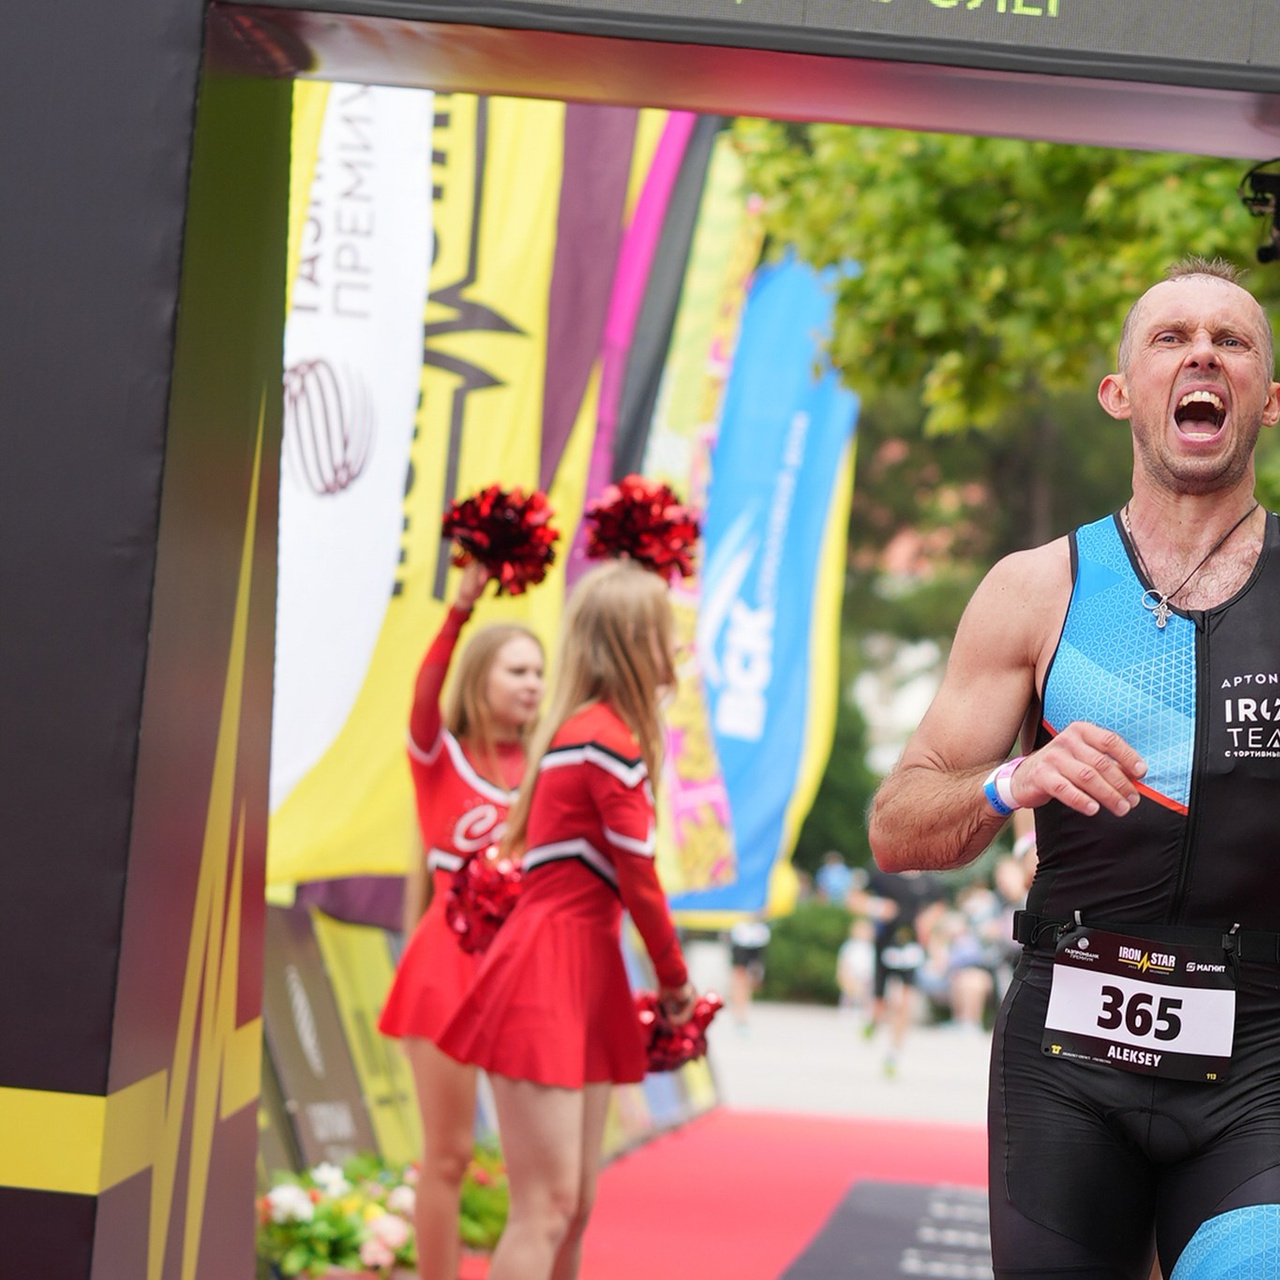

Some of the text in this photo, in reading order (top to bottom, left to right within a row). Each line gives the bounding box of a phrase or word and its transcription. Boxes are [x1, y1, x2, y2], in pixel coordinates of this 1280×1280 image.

[1119, 946, 1177, 968] IRON STAR
[1196, 963, 1226, 973] МАГНИТ
[1096, 985, 1183, 1041] 365
[1107, 1045, 1162, 1068] ALEKSEY
